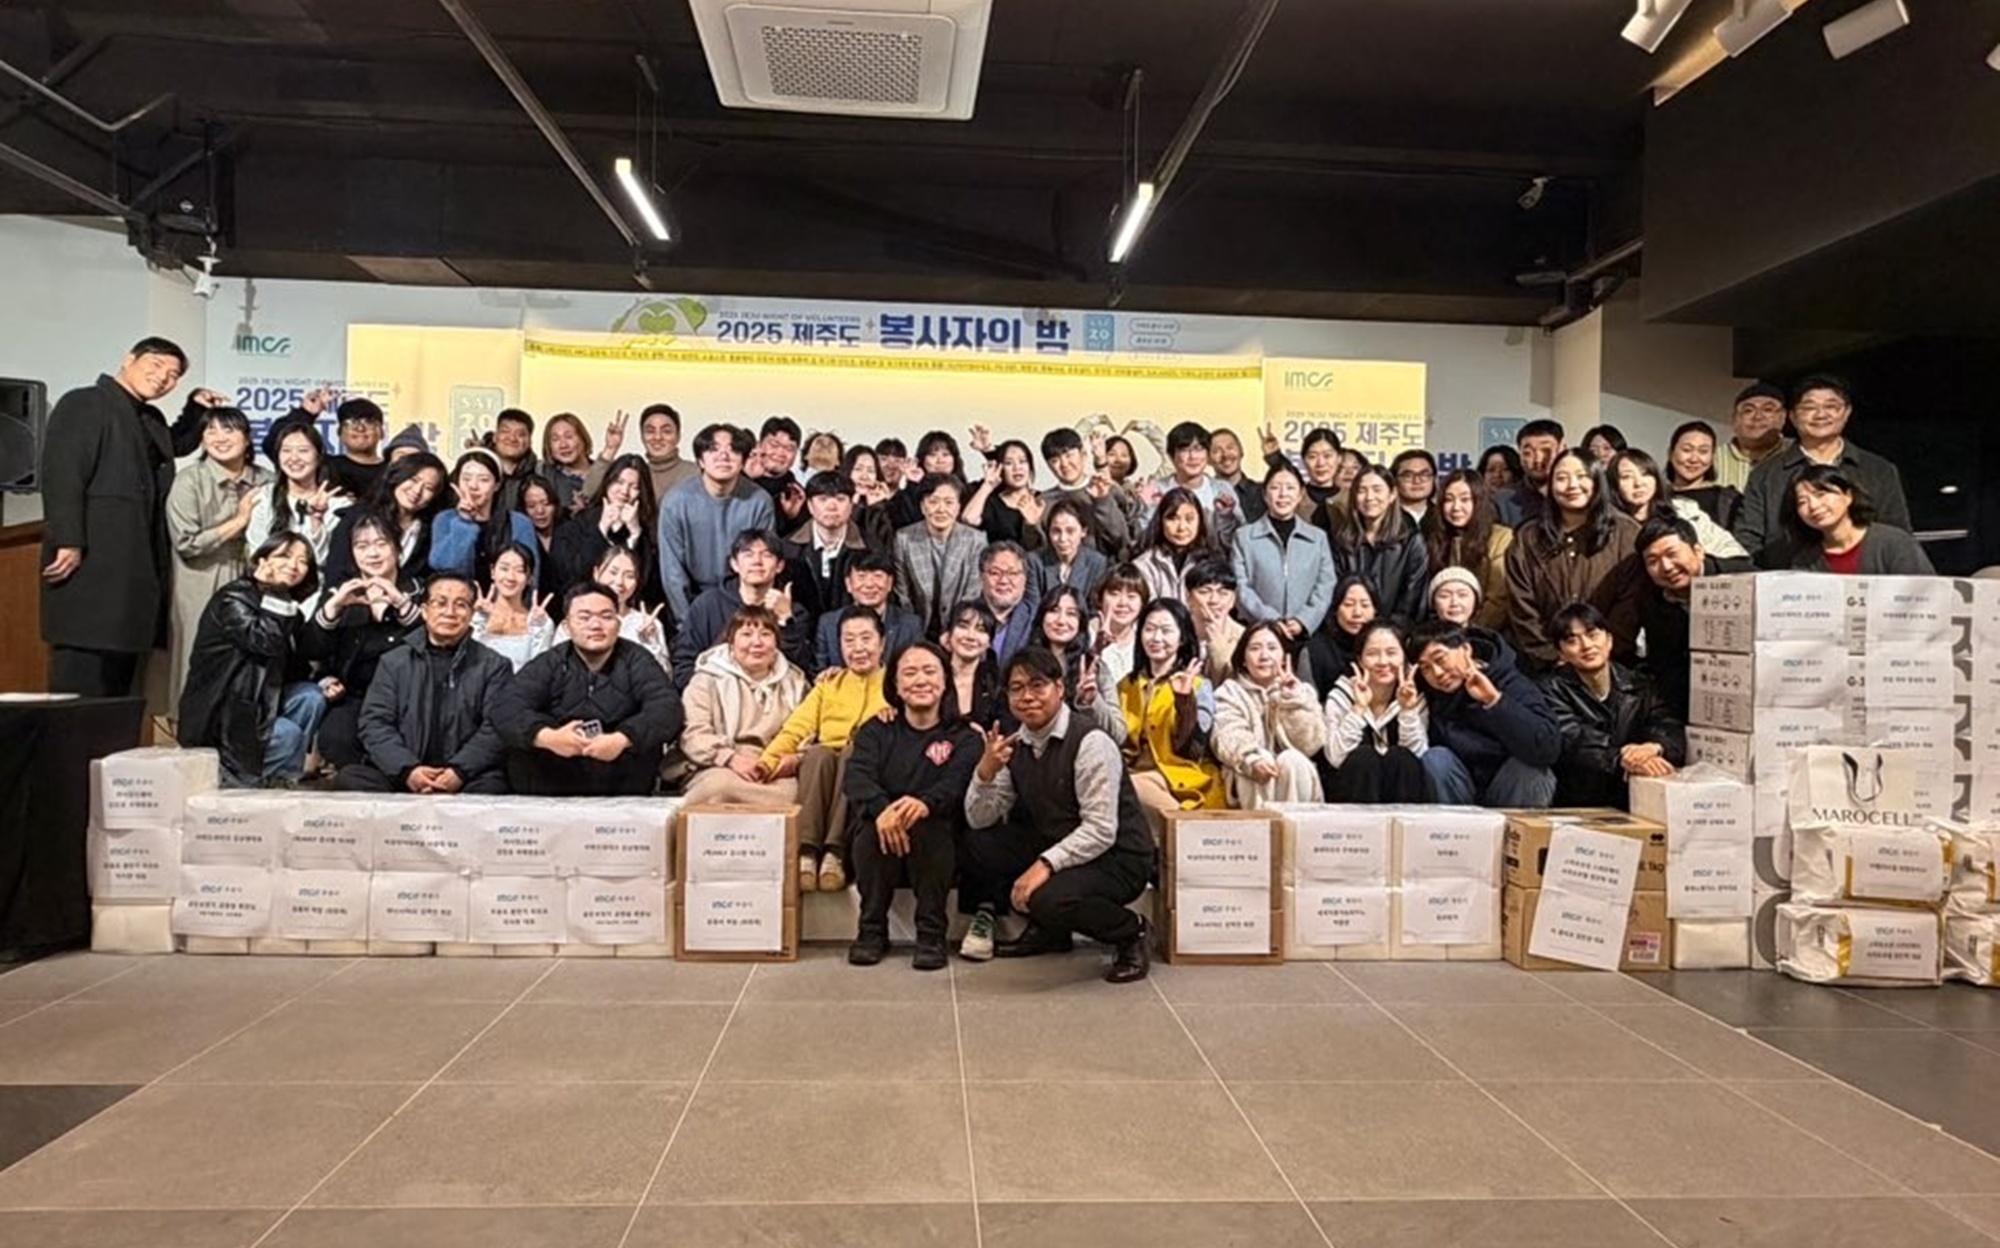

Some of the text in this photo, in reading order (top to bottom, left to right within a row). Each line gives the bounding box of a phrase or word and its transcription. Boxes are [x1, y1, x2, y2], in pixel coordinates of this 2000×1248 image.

[717, 320, 861, 348] 2025 제주도
[880, 314, 1071, 355] 봉사자의 밤
[236, 386, 305, 412] 2025
[1356, 421, 1423, 446] 제주도
[1812, 807, 1909, 826] MAROCELL
